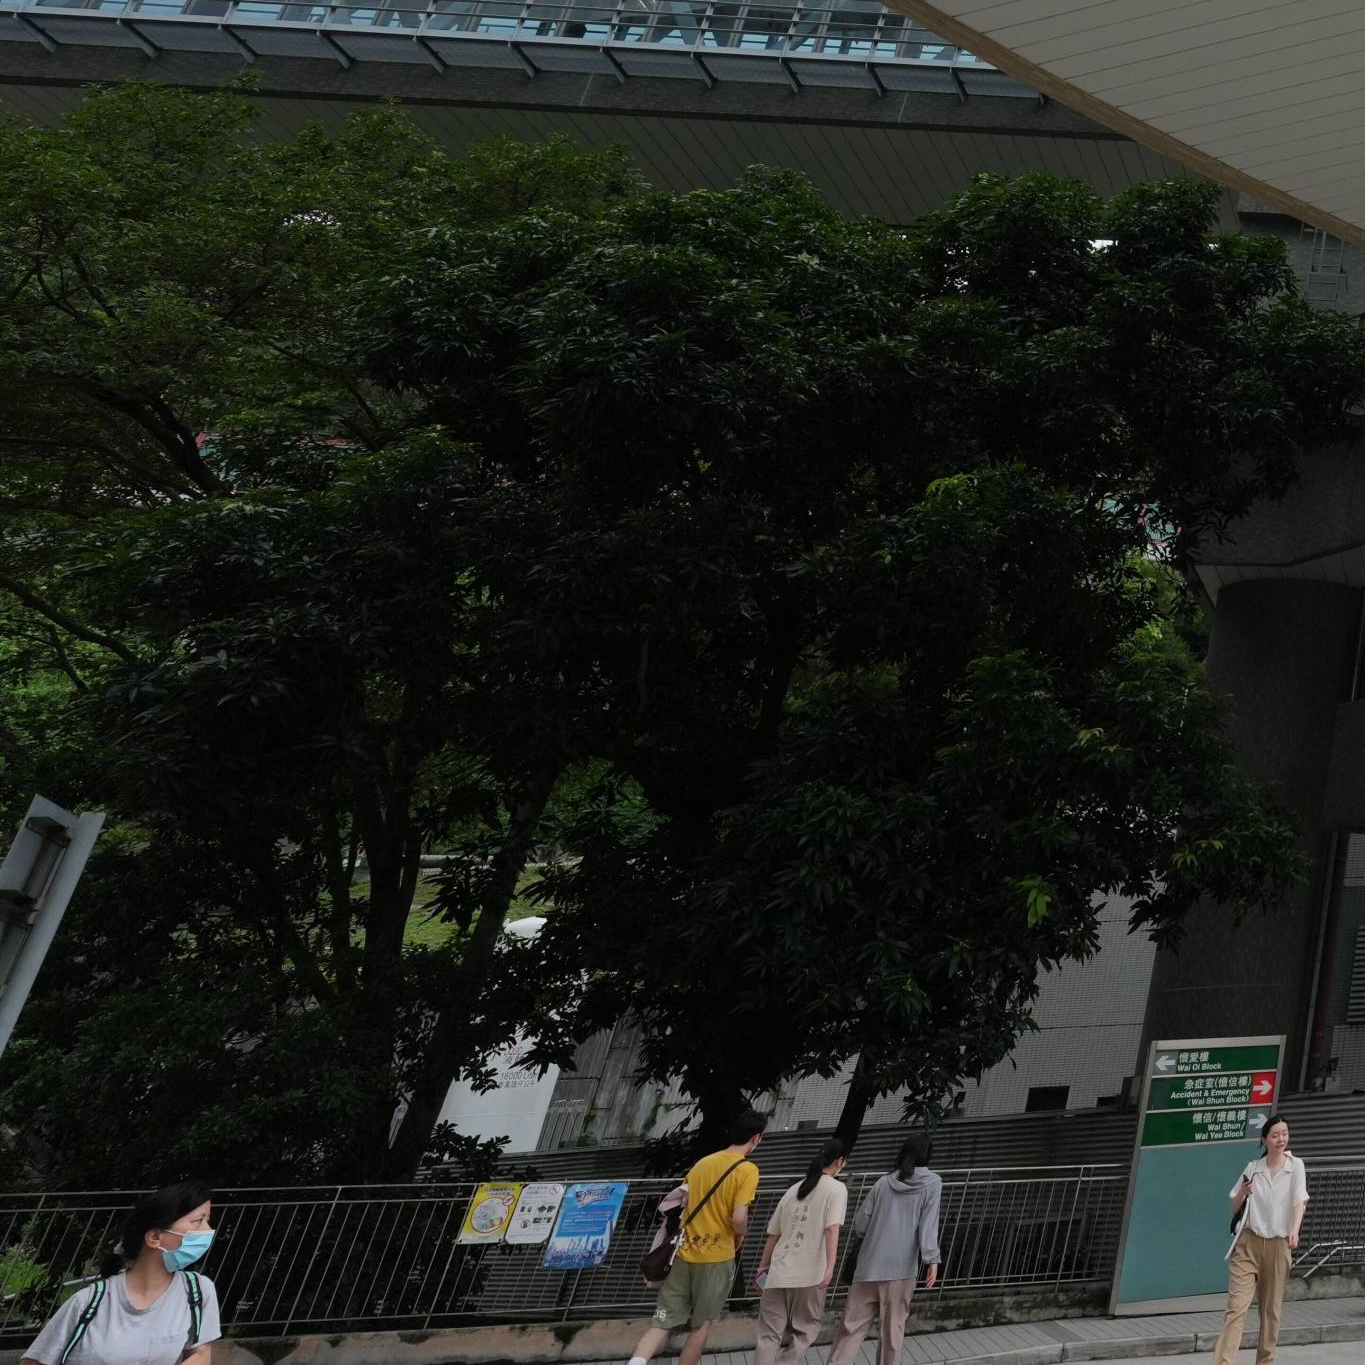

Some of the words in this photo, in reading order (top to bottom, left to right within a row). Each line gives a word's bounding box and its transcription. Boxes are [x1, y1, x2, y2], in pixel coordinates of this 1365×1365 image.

[1177, 1064, 1191, 1072] Wai
[1192, 1063, 1200, 1071] Oi
[1202, 1062, 1222, 1070] Block
[1171, 1089, 1202, 1099] Accident
[1204, 1089, 1209, 1097] &
[1211, 1087, 1250, 1097] Emergency
[1206, 1096, 1225, 1105] Shun
[1226, 1095, 1250, 1104] Block)
[1207, 1123, 1221, 1131] Wai
[1195, 1132, 1208, 1140] Wai
[1209, 1131, 1223, 1139] Yee
[1224, 1130, 1244, 1138] Block
